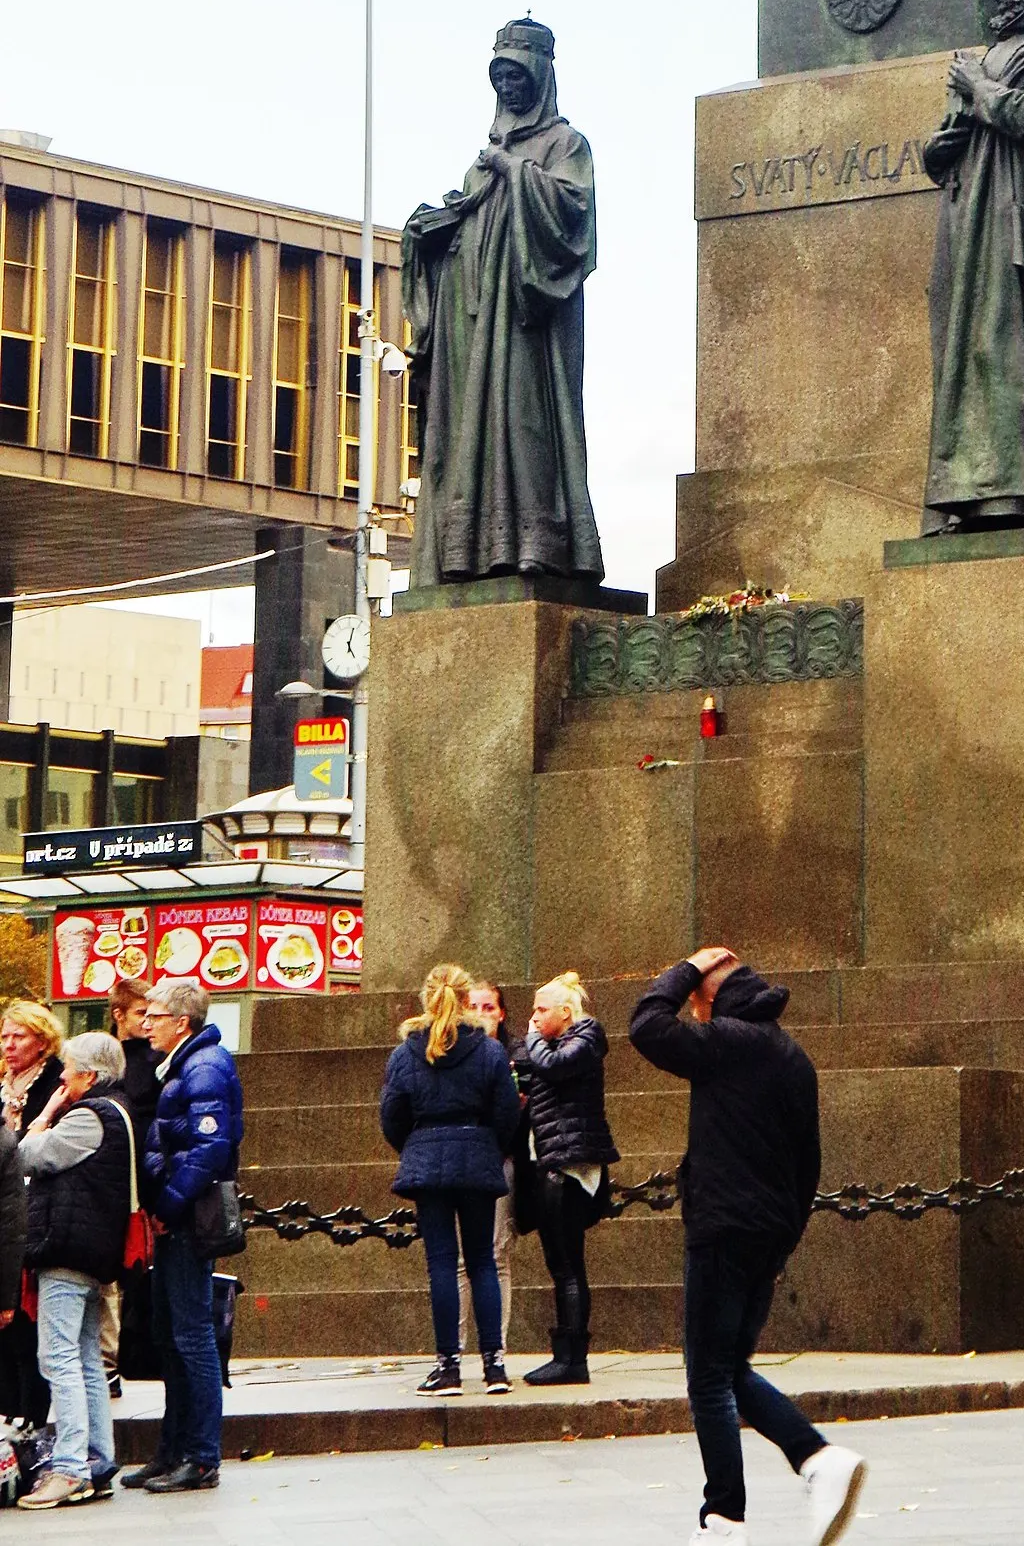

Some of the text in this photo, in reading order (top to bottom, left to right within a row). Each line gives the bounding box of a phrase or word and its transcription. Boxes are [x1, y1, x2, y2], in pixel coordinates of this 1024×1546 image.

[298, 722, 345, 743] BILLA
[206, 906, 249, 923] KEBAB
[295, 909, 327, 925] KEBAB
